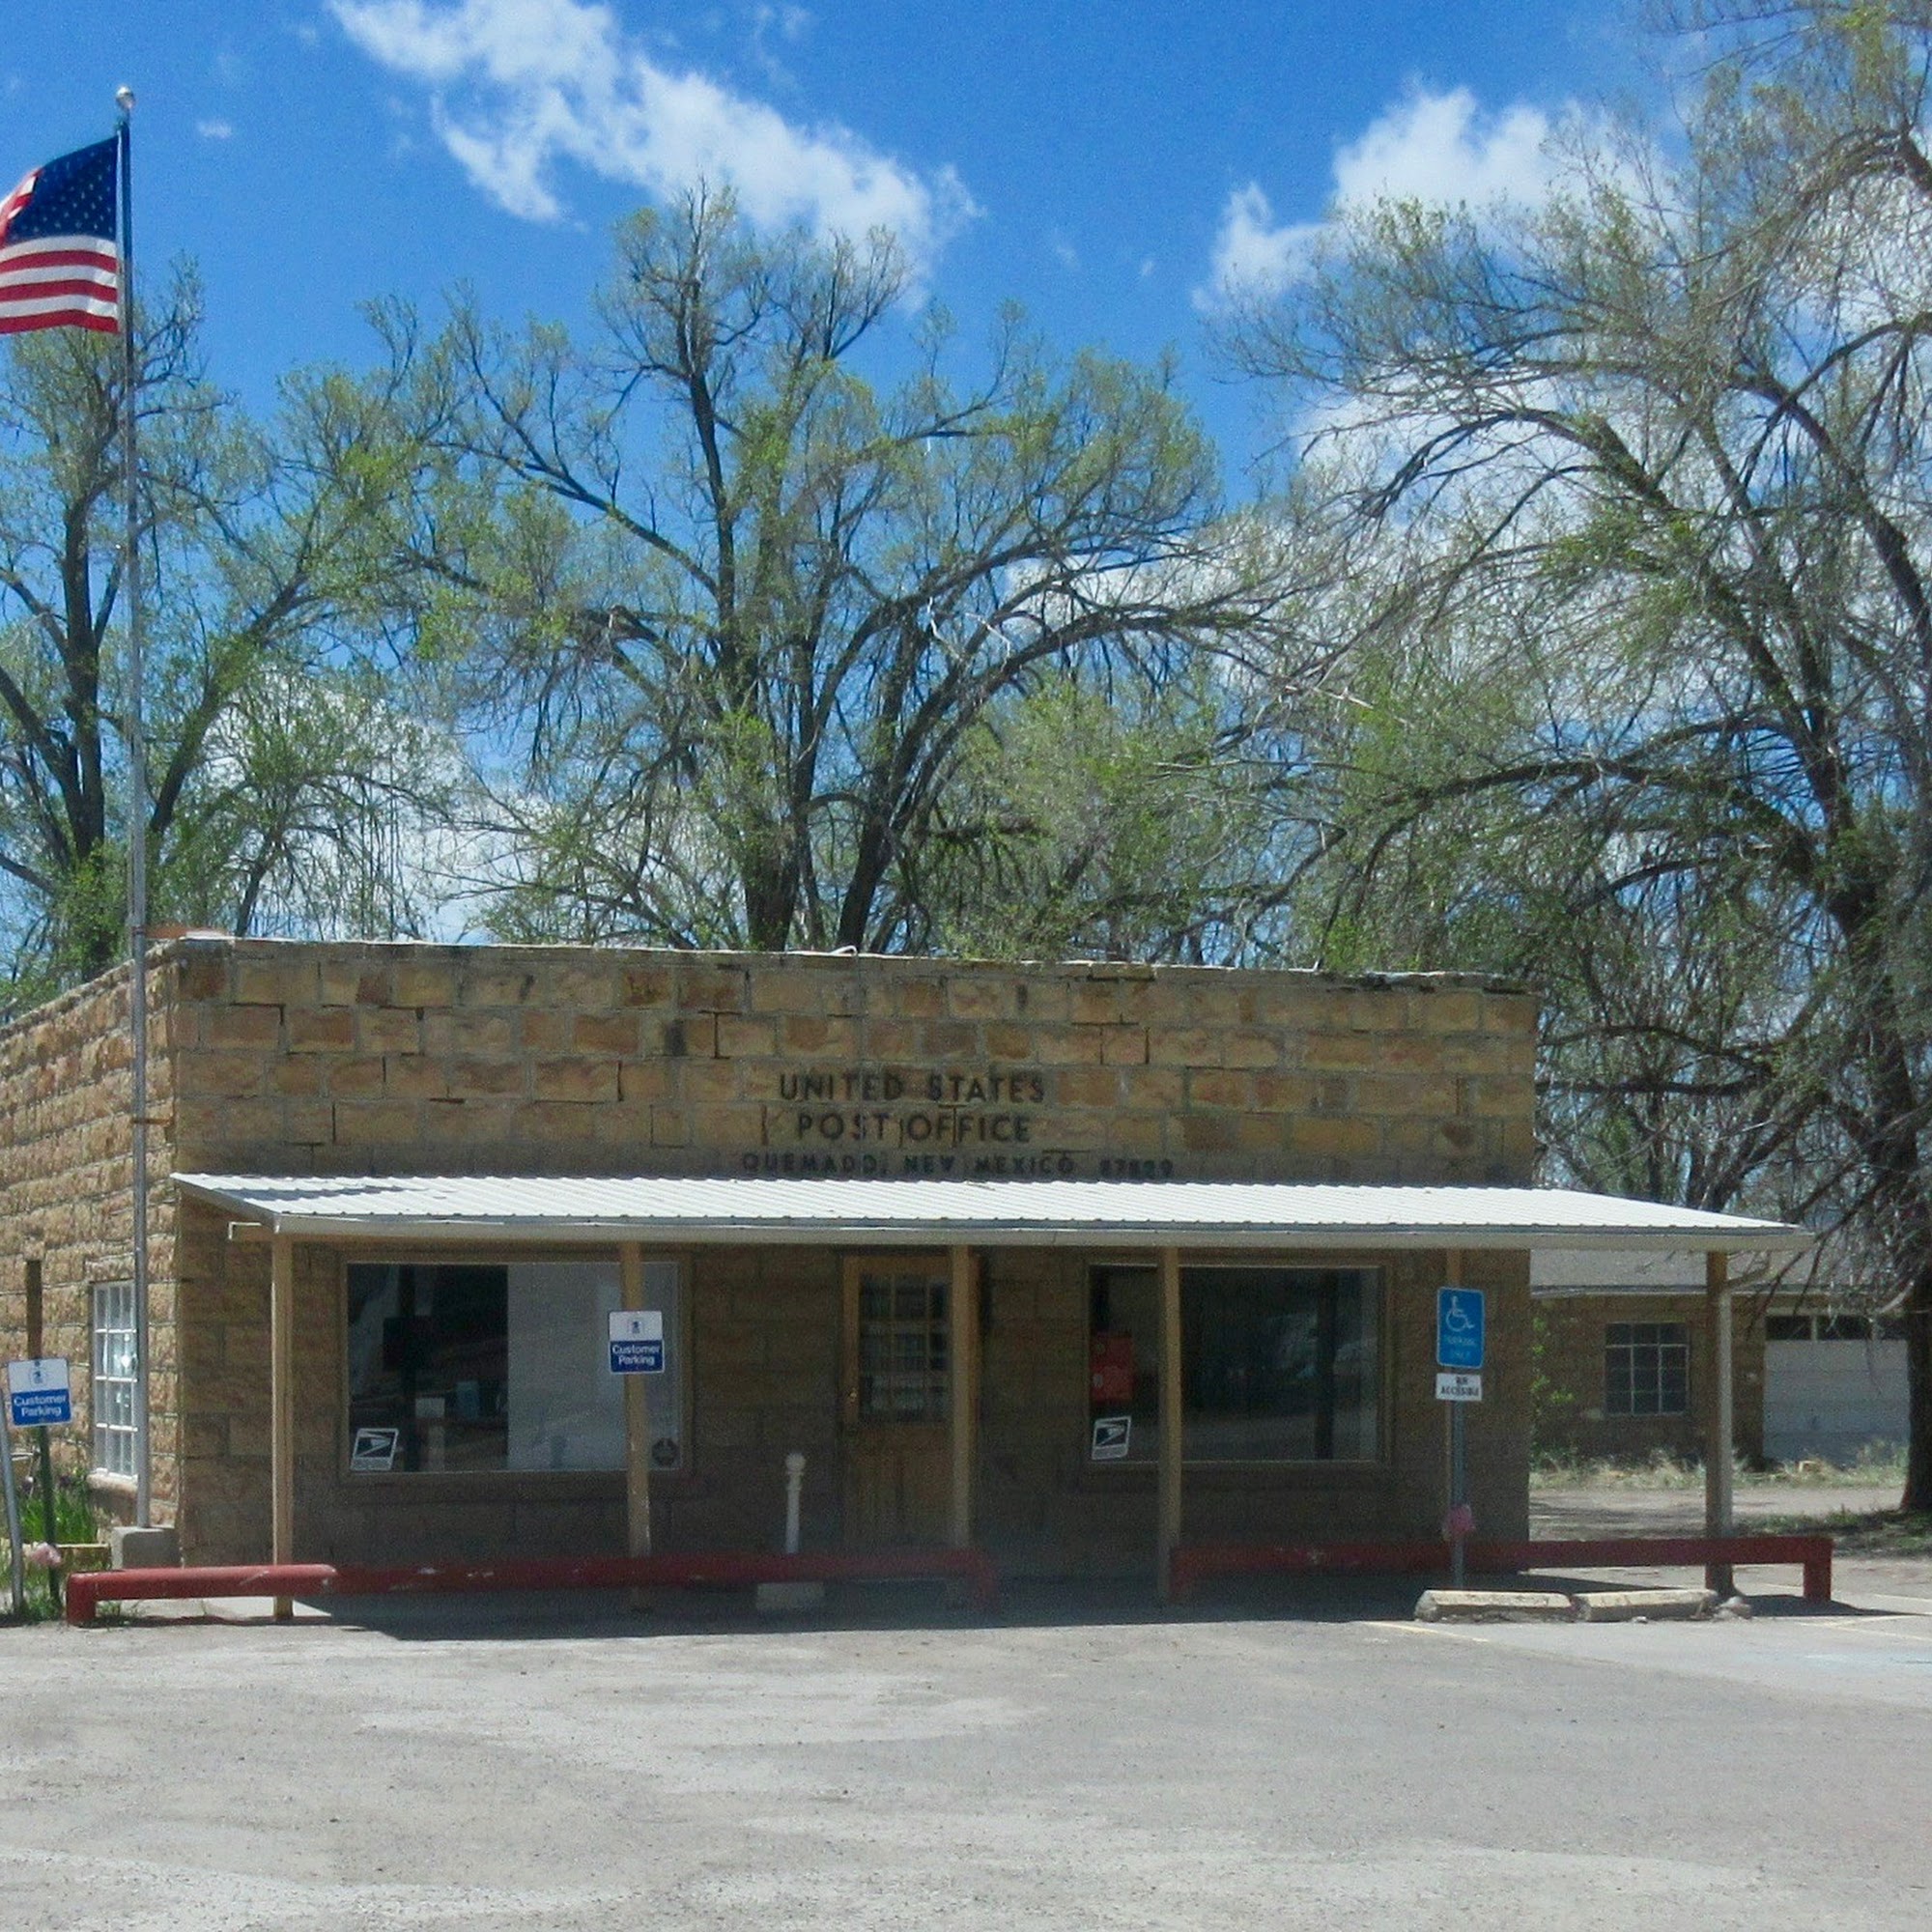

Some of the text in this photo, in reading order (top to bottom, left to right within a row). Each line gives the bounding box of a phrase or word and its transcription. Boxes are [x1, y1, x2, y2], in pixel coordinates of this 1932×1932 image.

[781, 1072, 1045, 1103] UNITED STATES
[799, 1113, 1031, 1143] POST OFFICE
[904, 1154, 955, 1174] NEW
[974, 1155, 1074, 1176] MEXICO
[611, 1344, 661, 1354] Customer
[618, 1354, 655, 1366] Parking
[14, 1395, 67, 1406] Customer
[21, 1406, 62, 1417] Parking
